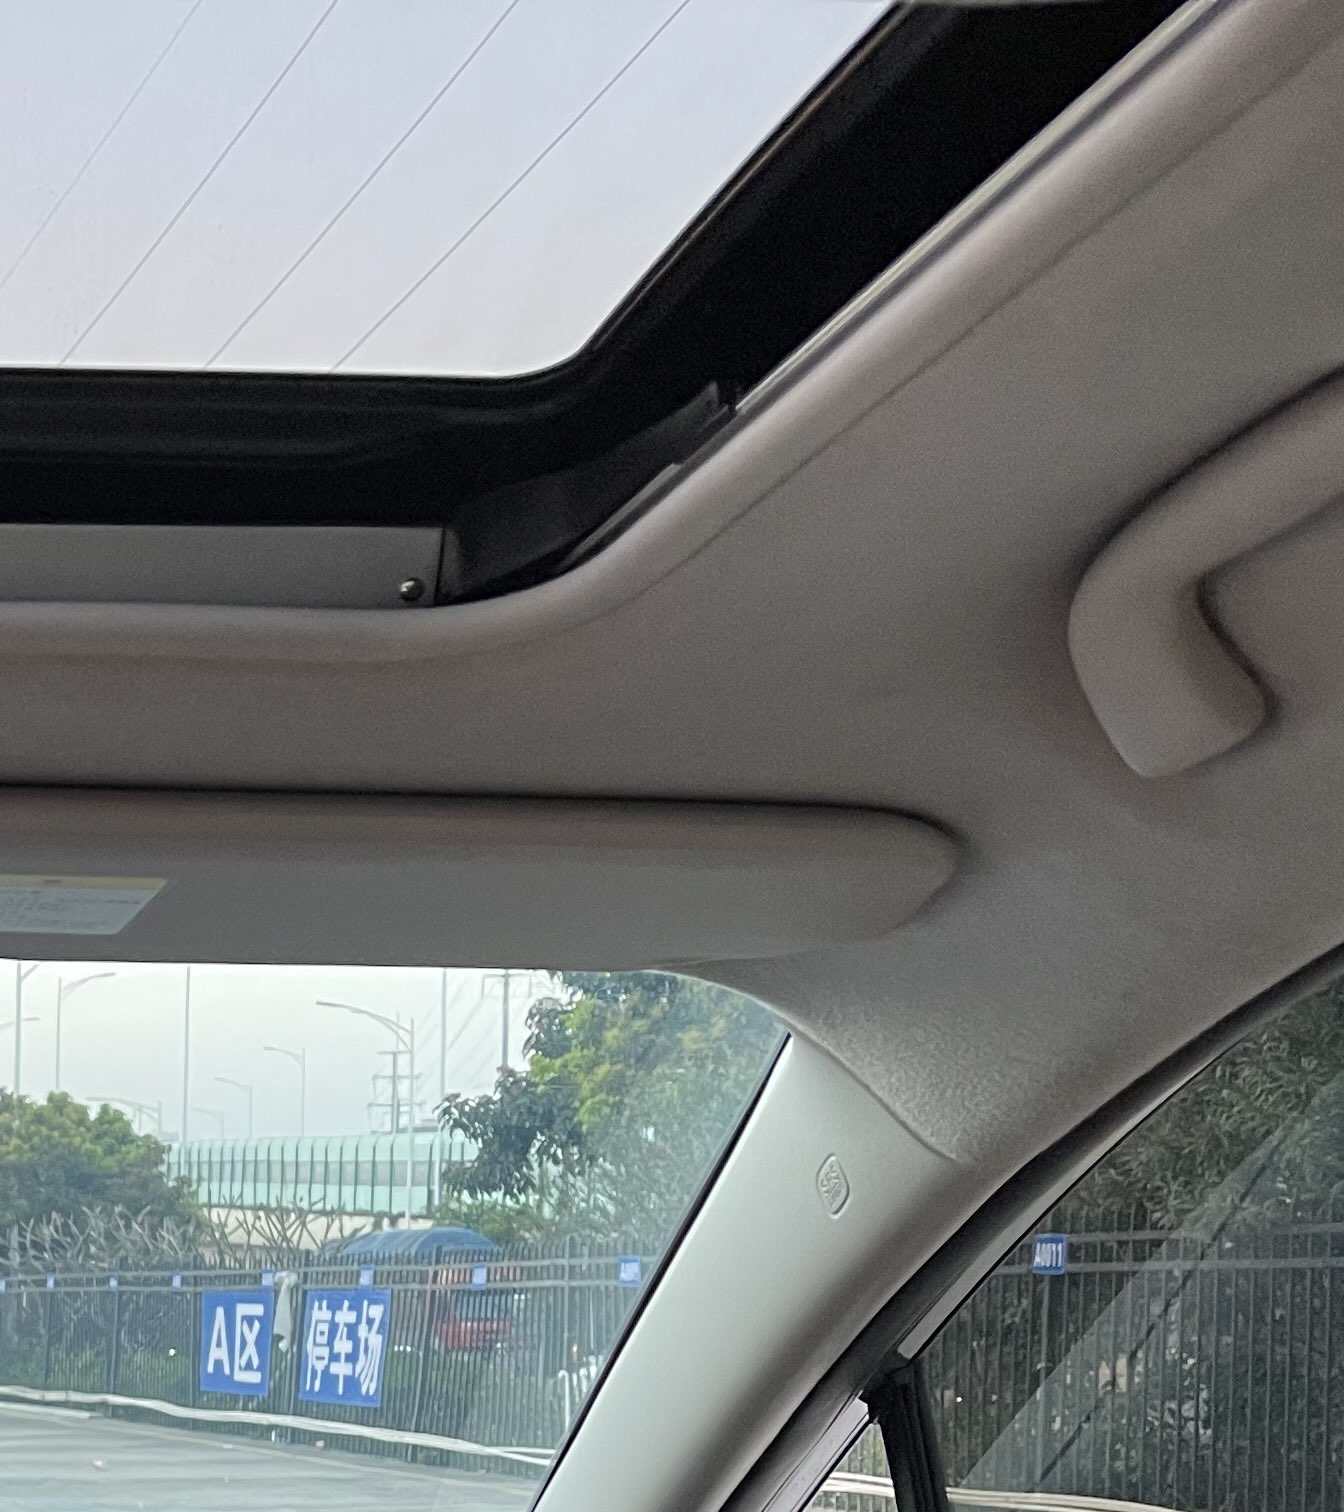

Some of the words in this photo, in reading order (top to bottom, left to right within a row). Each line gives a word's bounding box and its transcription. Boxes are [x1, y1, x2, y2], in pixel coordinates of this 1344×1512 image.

[206, 1302, 265, 1384] A区
[305, 1299, 385, 1397] 停车场
